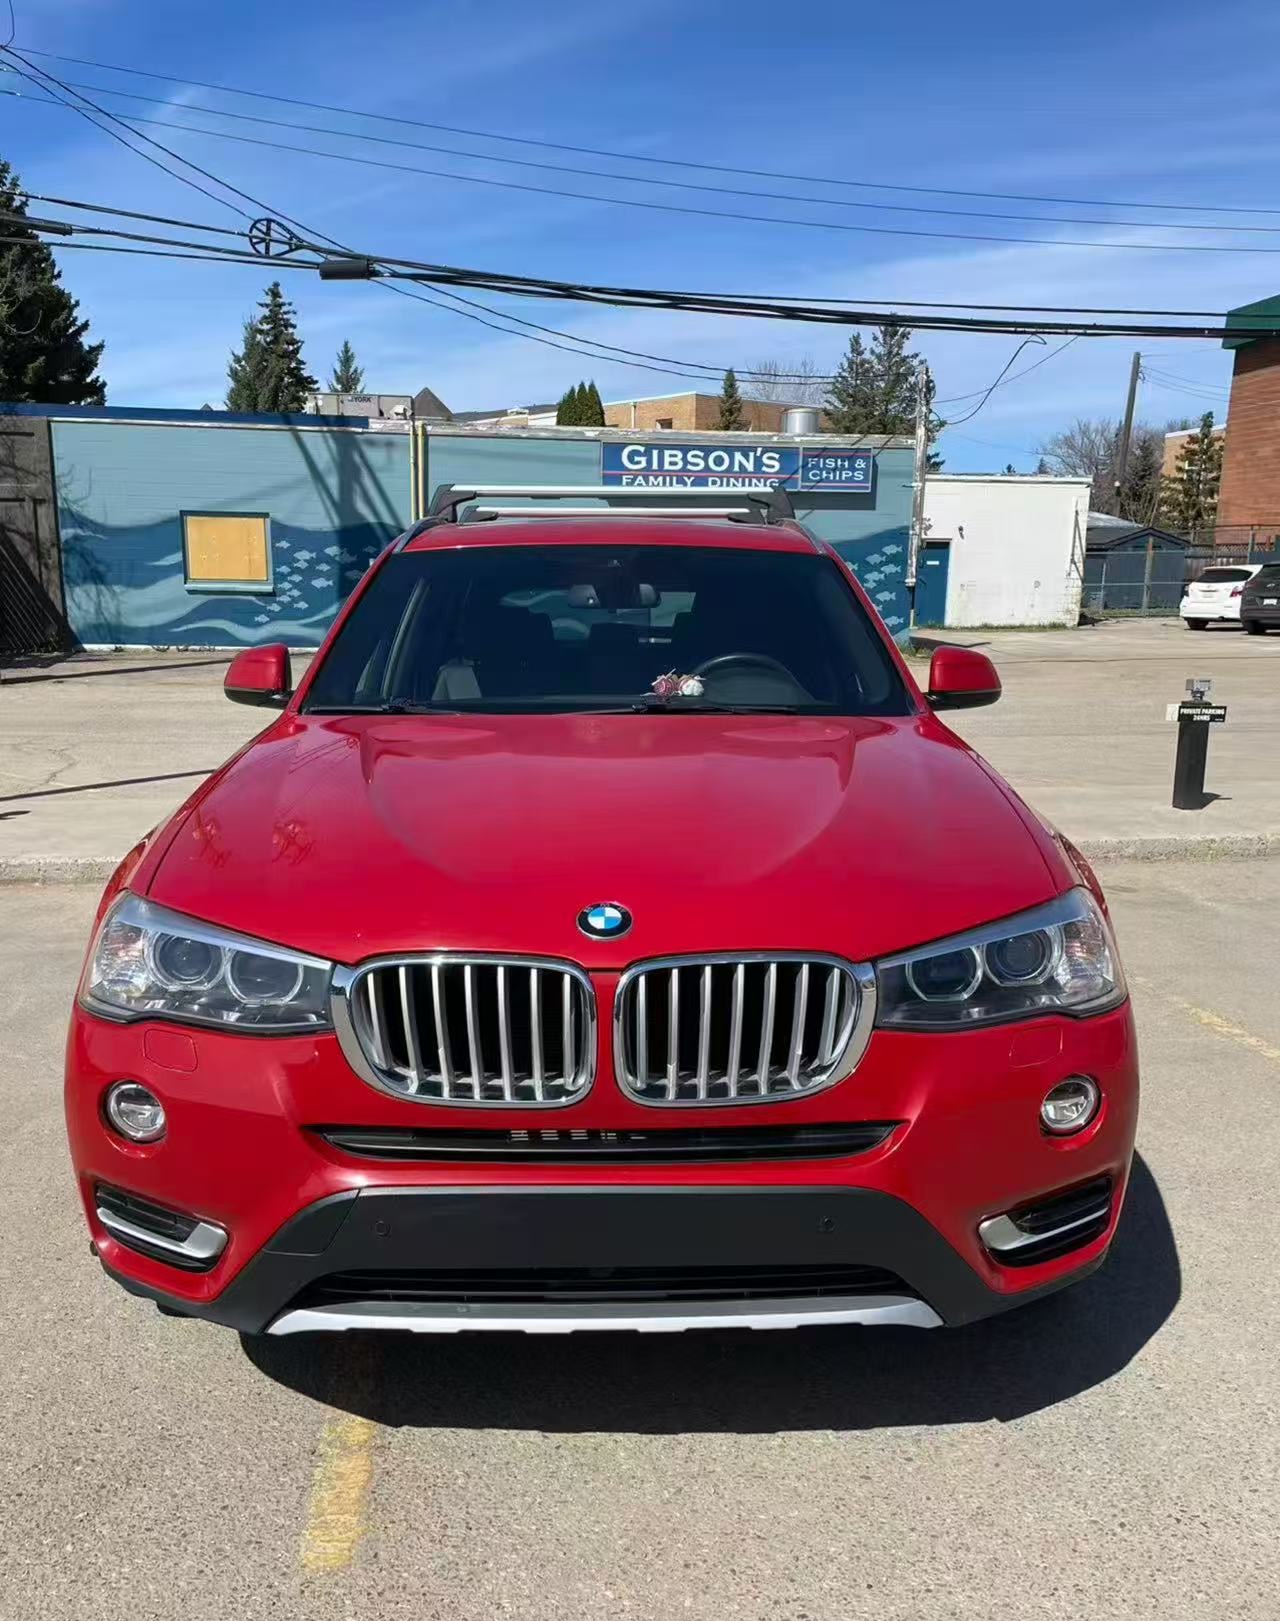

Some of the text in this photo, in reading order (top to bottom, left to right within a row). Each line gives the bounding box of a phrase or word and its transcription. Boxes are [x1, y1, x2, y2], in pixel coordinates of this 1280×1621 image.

[621, 445, 780, 473] GIBSON'S
[807, 458, 867, 469] FISH &
[621, 475, 779, 488] FAMILY DINING
[808, 470, 865, 481] CHIPS
